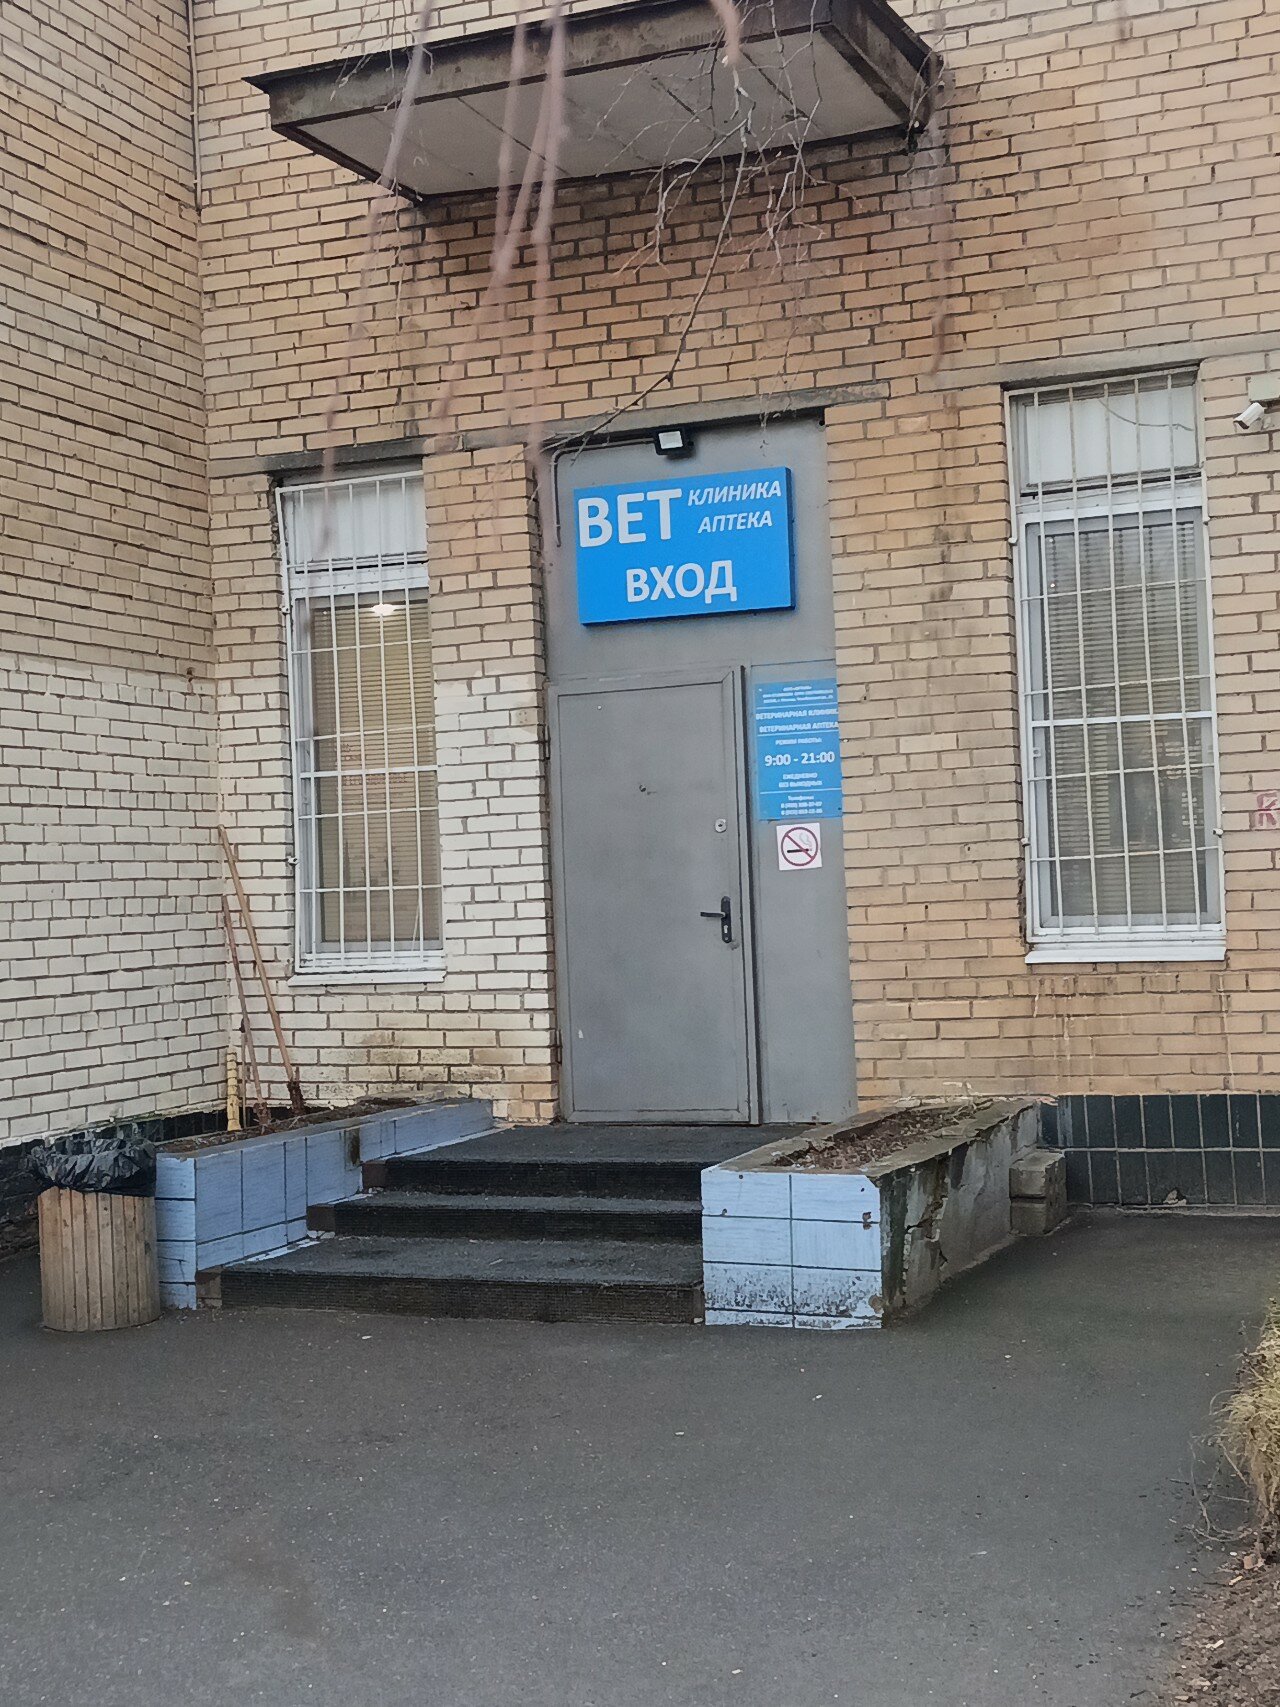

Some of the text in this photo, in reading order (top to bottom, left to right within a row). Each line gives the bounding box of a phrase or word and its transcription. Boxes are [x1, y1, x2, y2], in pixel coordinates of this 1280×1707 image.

[687, 480, 782, 506] КЛИНИКА
[578, 488, 682, 547] ВЕТ
[698, 510, 773, 533] АПТЕКА
[626, 559, 737, 604] ВХОД
[756, 710, 807, 720] ВЕТЕРИНАРНАЯ
[759, 721, 839, 733] ВЕТЕРИНАРНАЯ АПТЕКА
[764, 753, 791, 766] 9:00
[801, 751, 835, 764] 21:00
